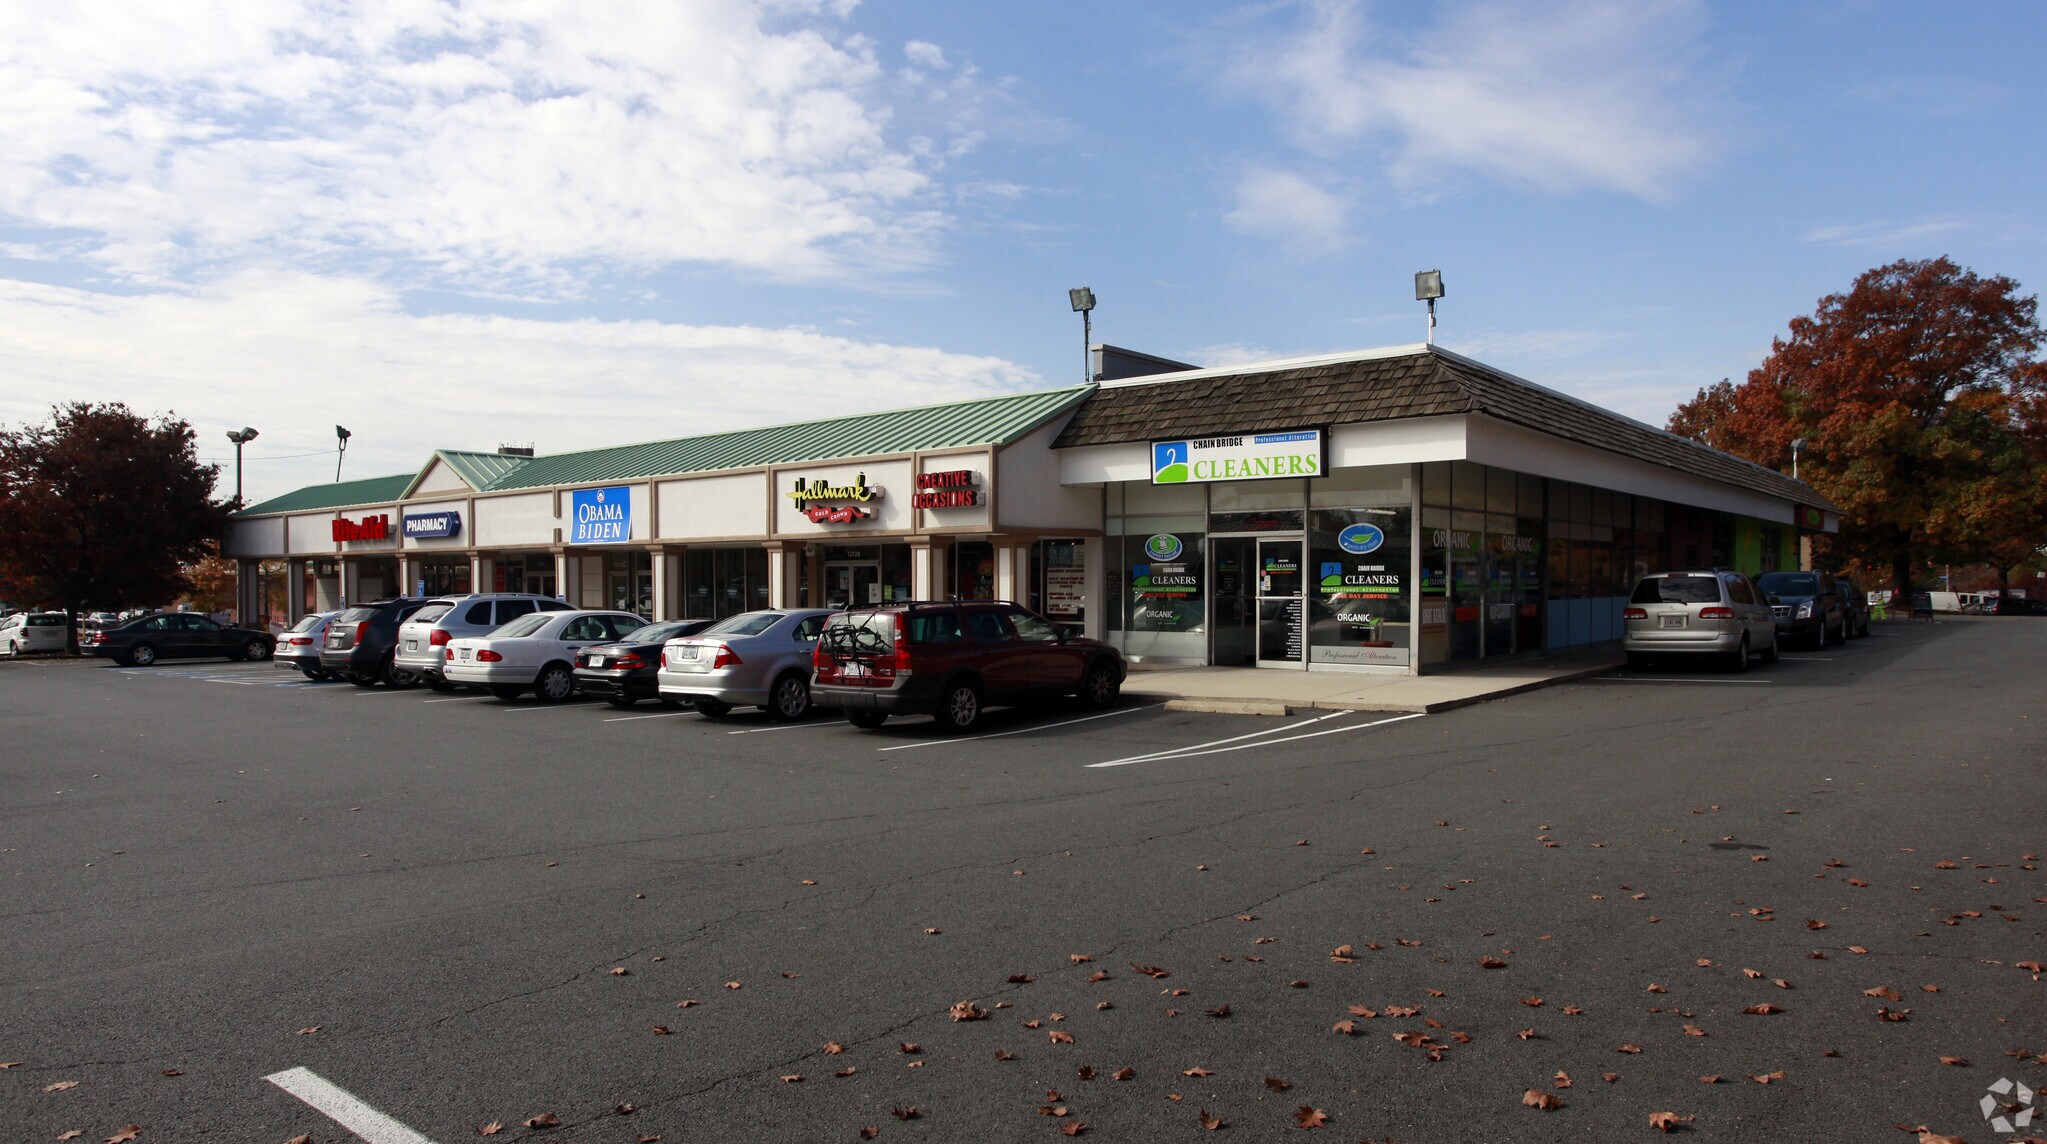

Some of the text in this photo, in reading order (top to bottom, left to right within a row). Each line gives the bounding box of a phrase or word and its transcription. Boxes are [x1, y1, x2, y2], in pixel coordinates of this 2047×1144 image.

[1193, 437, 1243, 450] CHAIN BRIDGE
[1254, 434, 1288, 444] Professional
[1193, 453, 1318, 480] CLEANERS
[917, 470, 968, 489] CREATIVE
[785, 473, 872, 513] Hallmark
[911, 489, 973, 509] OCCASIONS
[578, 503, 624, 524] OBAMA
[814, 509, 829, 517] GOLD
[830, 511, 848, 521] CROWN
[332, 513, 389, 542] Rite Aid
[406, 517, 448, 532] PHARMACY
[578, 522, 622, 540] BIDEN
[1152, 575, 1197, 585] CLEANERS
[1344, 574, 1399, 585] CLEANERS
[1146, 610, 1173, 619] ORGANIC
[1337, 613, 1371, 622] ORGANIC
